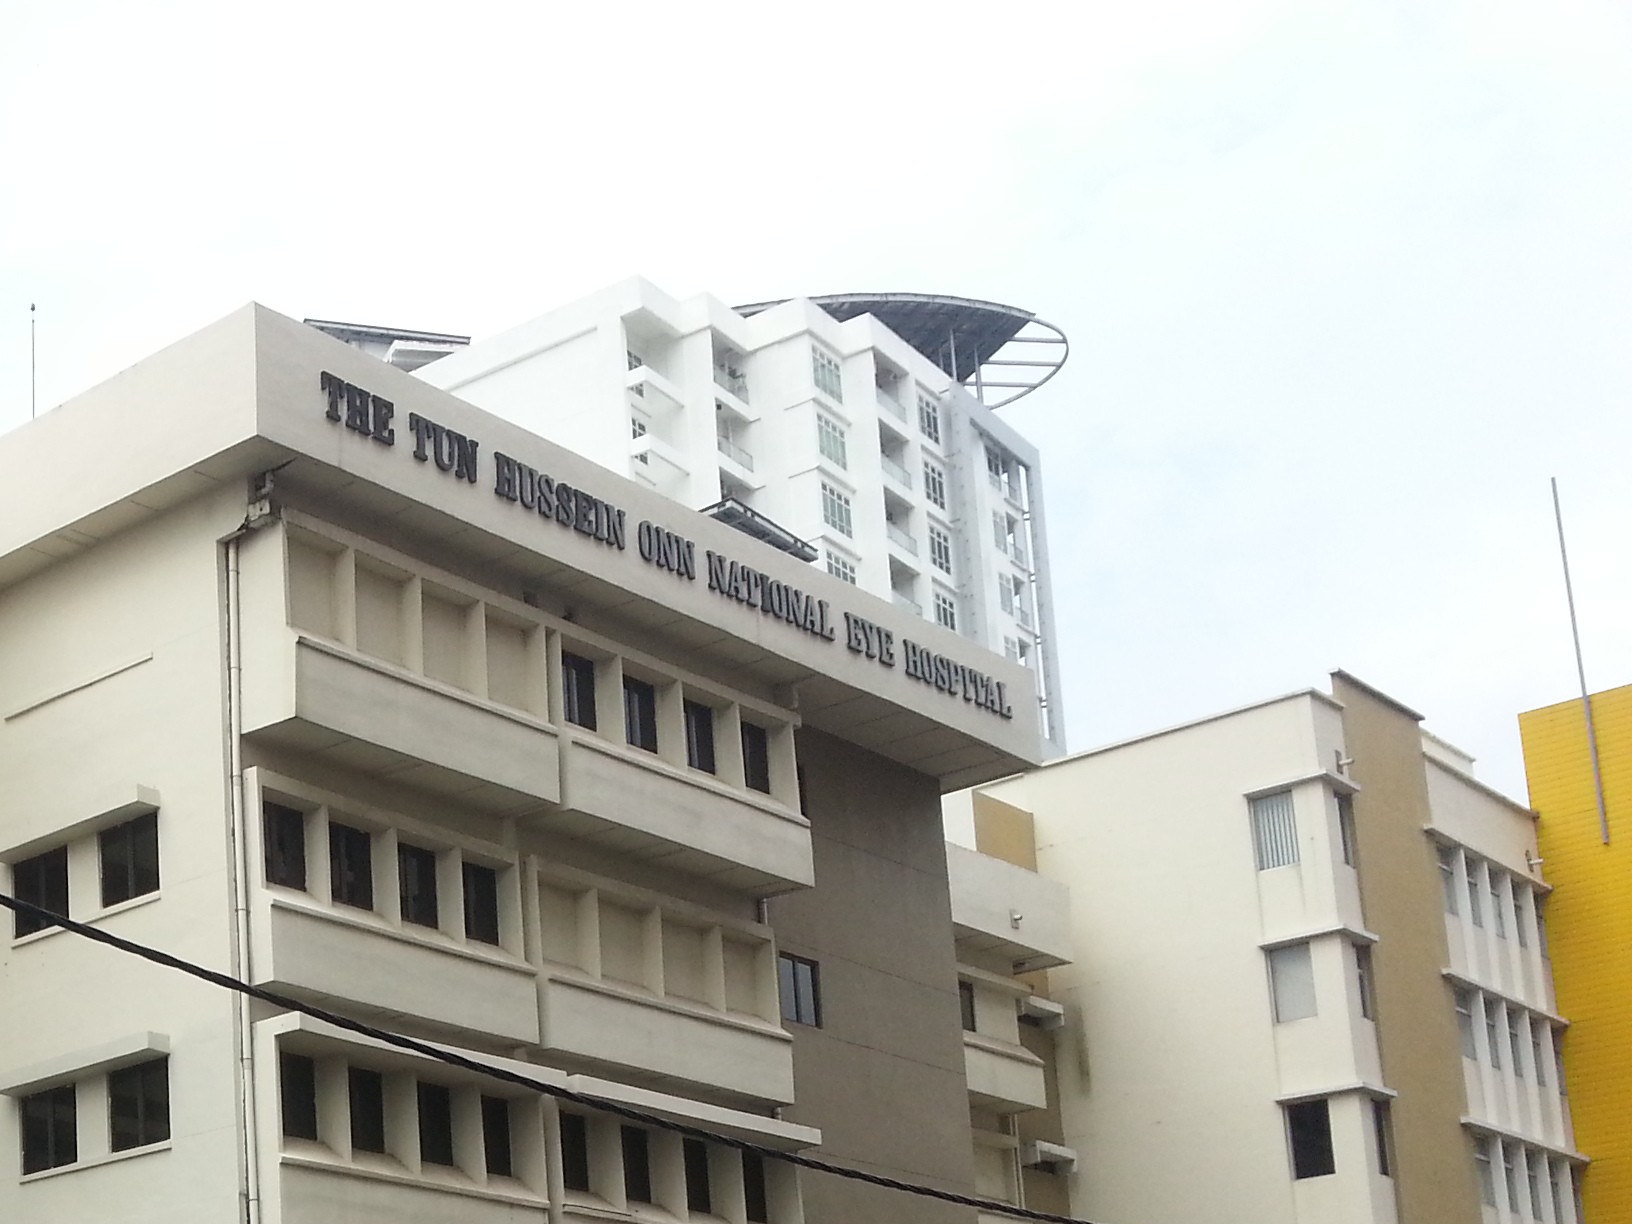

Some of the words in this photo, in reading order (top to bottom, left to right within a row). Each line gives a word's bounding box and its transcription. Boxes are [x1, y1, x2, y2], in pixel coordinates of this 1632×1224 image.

[320, 370, 395, 446] THE
[409, 411, 479, 483] TUN
[494, 451, 626, 550] HUSSEIN
[638, 520, 695, 580] ONN
[706, 550, 836, 641] NATIONAL
[844, 612, 896, 667] EYE
[903, 638, 1013, 719] HOSPITAL
